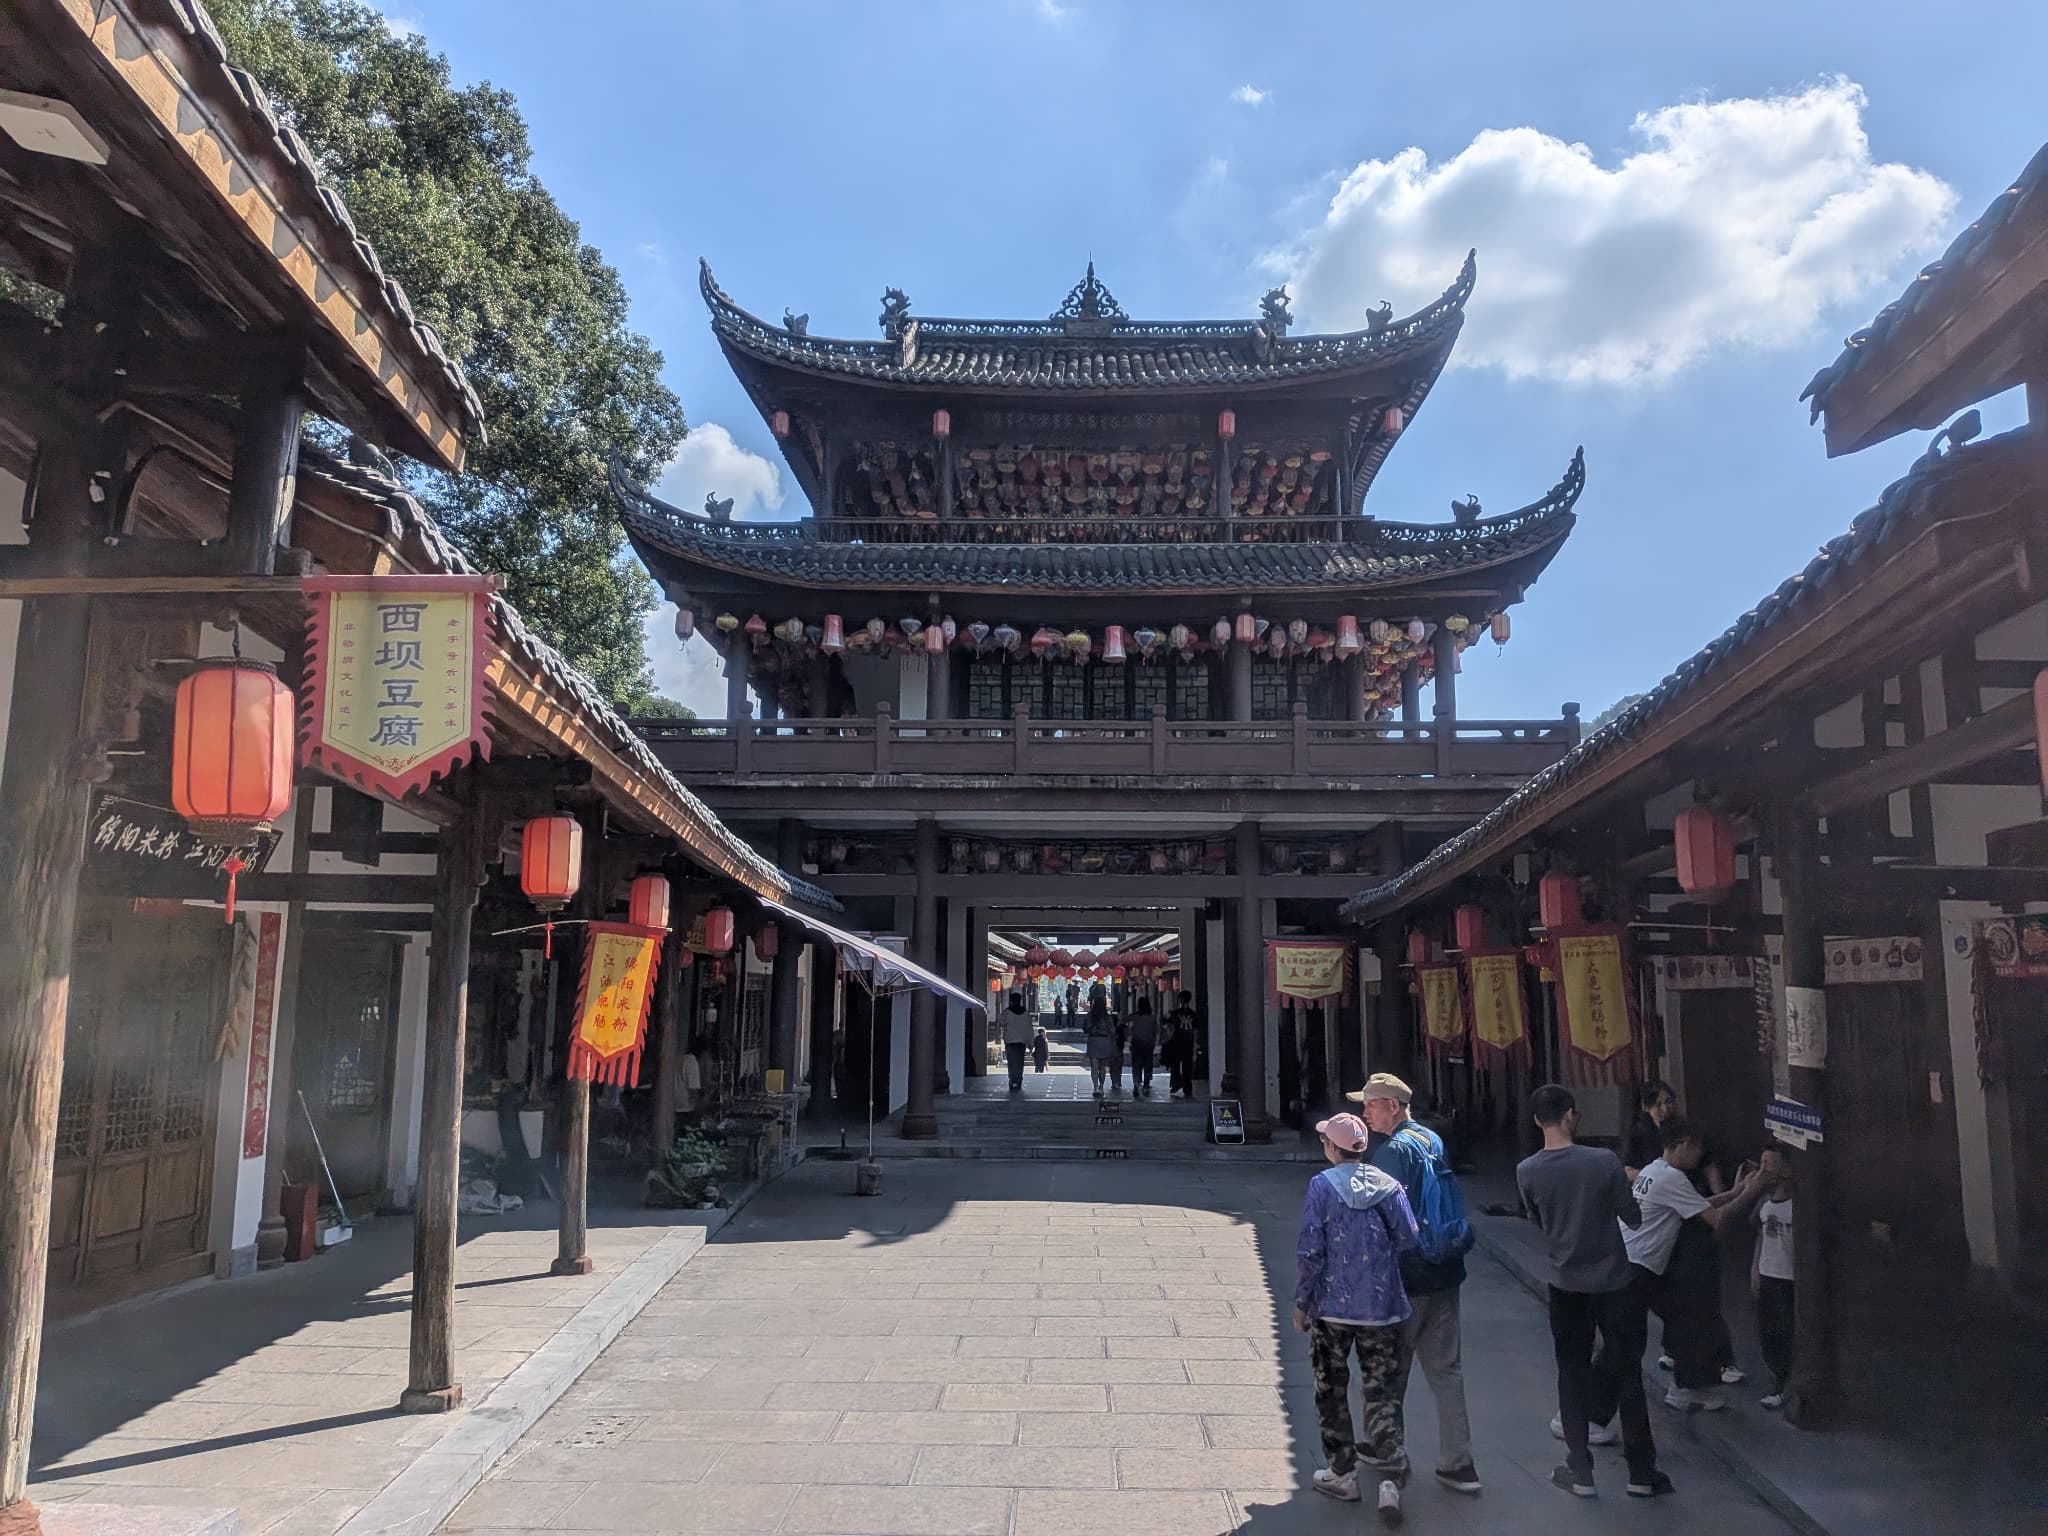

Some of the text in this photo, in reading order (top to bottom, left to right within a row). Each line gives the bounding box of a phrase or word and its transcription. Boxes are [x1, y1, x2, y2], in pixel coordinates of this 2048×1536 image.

[338, 623, 356, 731] 非物质文化遗产
[369, 603, 429, 747] 西坝豆腐
[612, 956, 638, 1033] 绵阳米粉
